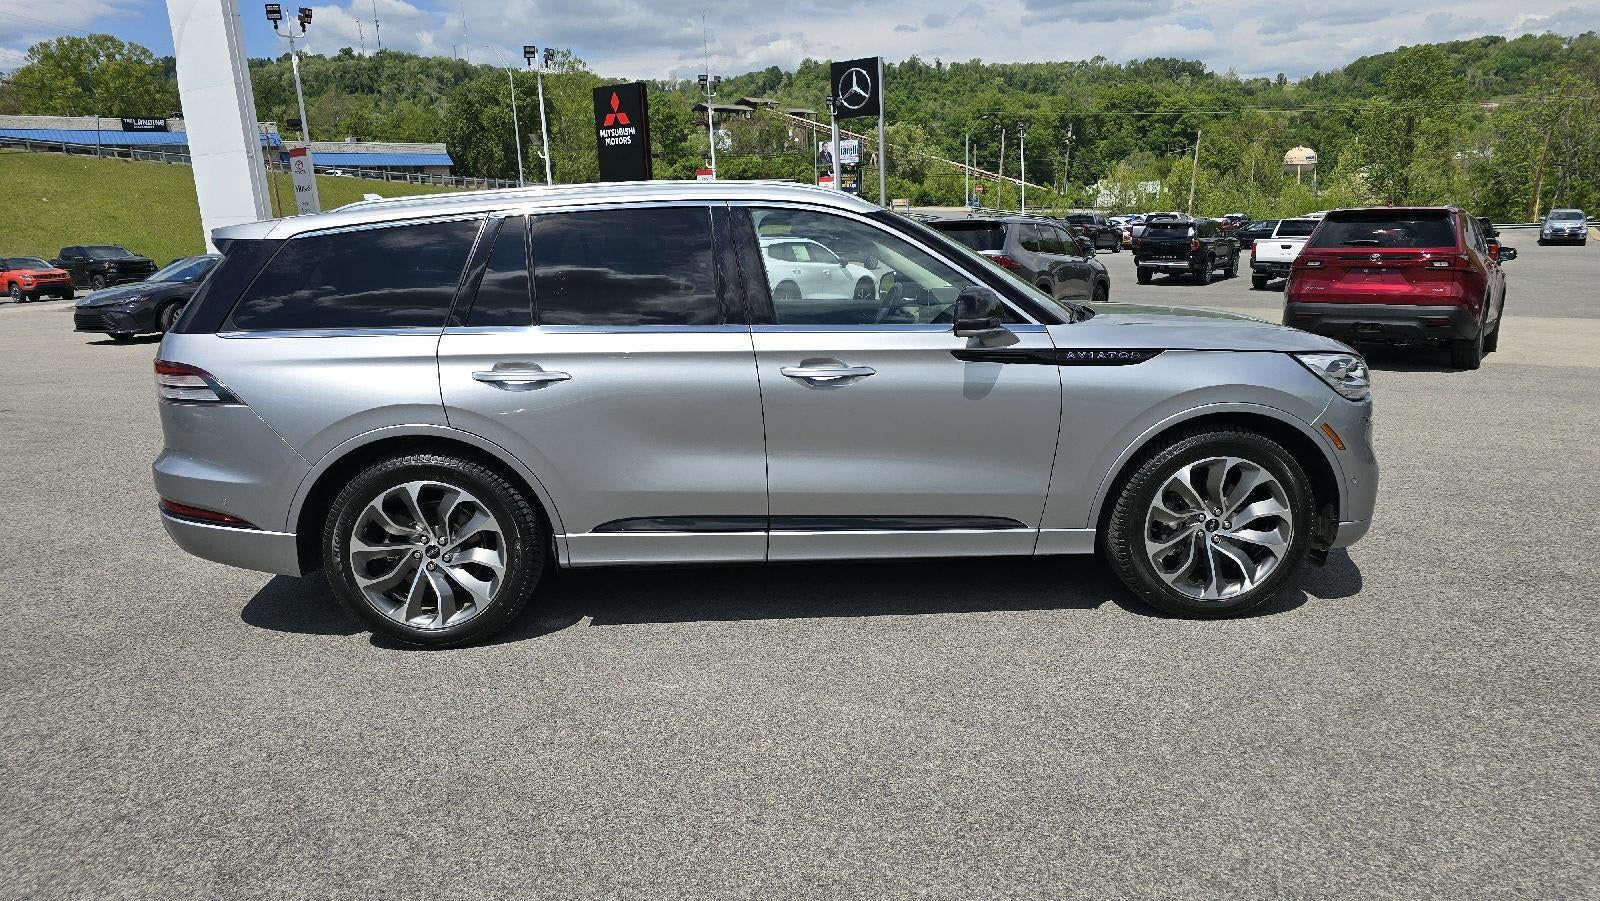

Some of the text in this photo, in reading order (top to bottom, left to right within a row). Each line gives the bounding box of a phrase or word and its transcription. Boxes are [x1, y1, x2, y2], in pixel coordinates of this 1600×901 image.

[600, 127, 636, 138] MITSUBISHI
[605, 136, 632, 146] MOTORS
[840, 145, 859, 156] iarelli
[1066, 351, 1141, 359] AVIATOR
